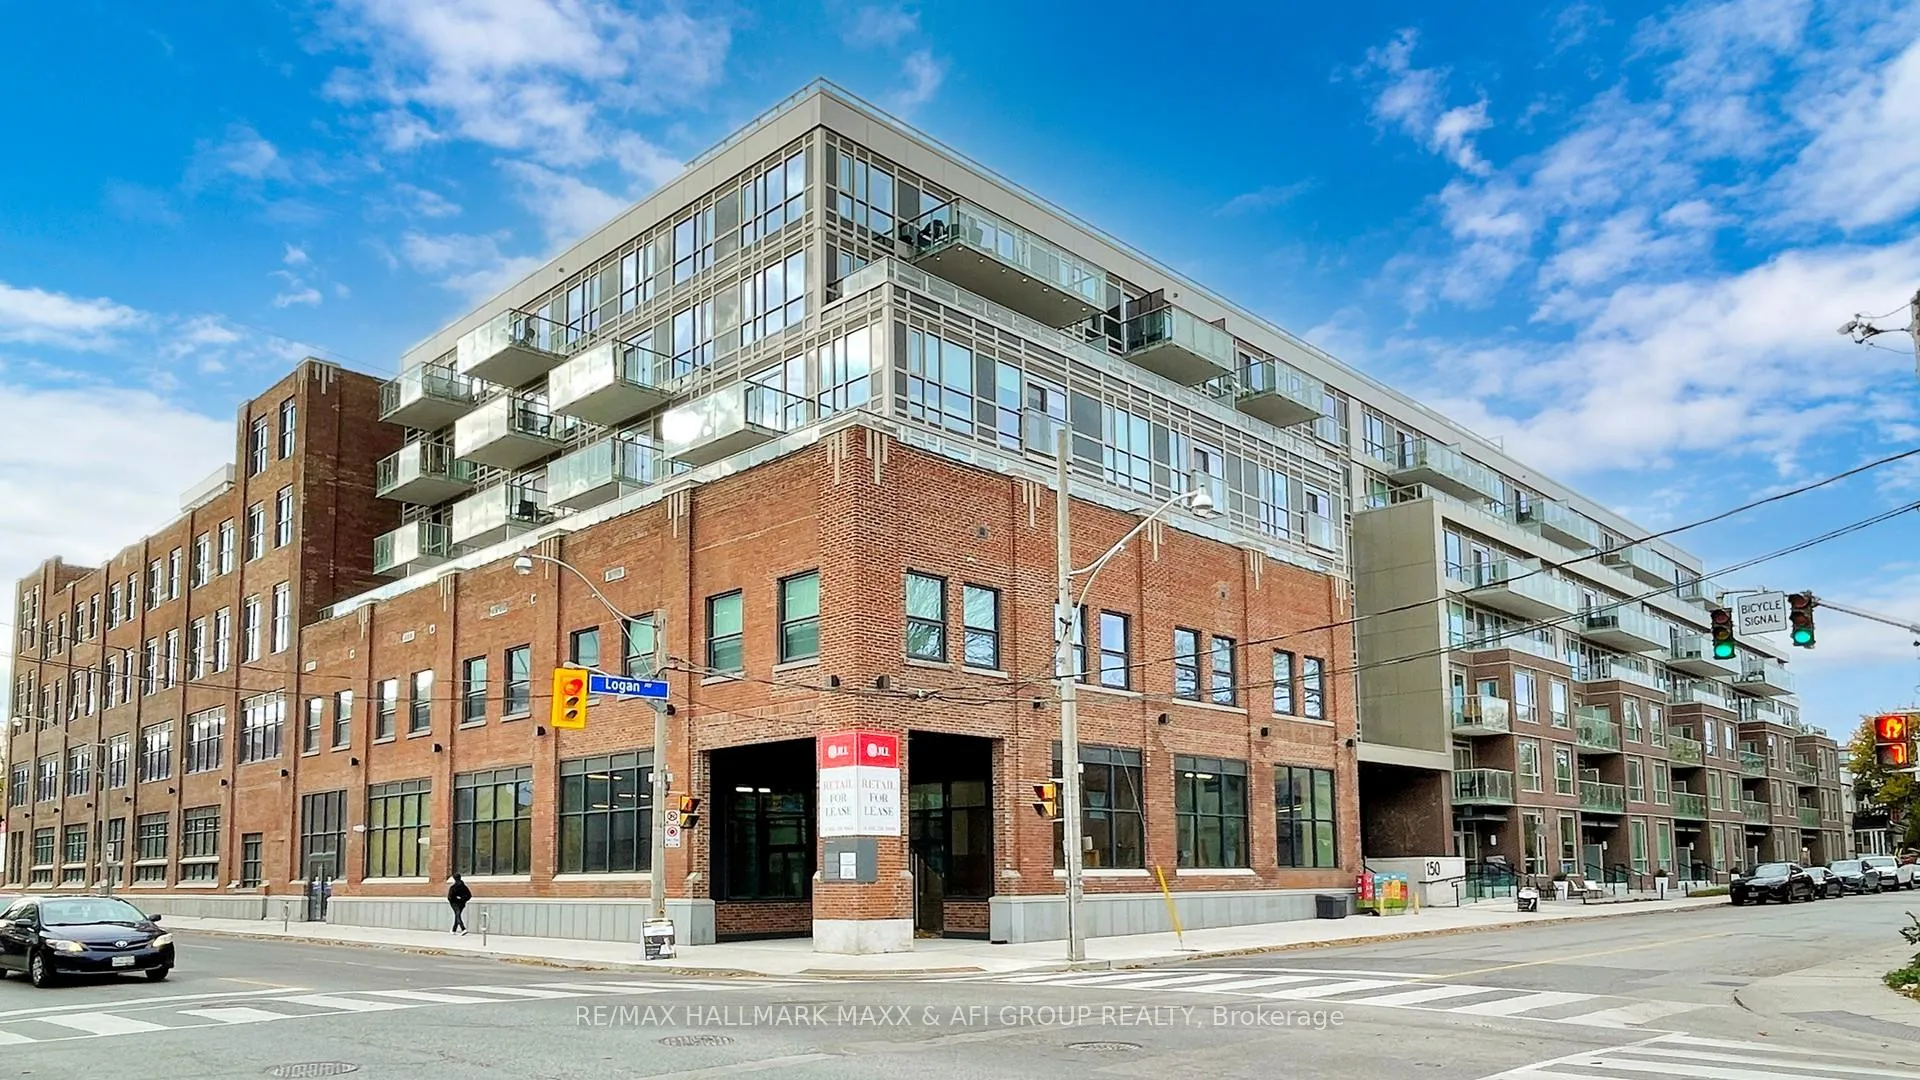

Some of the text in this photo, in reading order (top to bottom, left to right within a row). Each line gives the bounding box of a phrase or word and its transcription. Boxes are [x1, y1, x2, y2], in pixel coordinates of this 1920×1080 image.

[1741, 600, 1782, 614] BICYCLE
[1744, 614, 1780, 627] SIGNAL
[605, 678, 640, 694] Logan
[824, 779, 853, 790] RETAIL
[862, 779, 895, 790] RETAIL
[829, 793, 847, 803] FOR
[869, 792, 889, 803] FOR
[825, 805, 852, 817] LEASE
[864, 805, 894, 817] LEASE
[1426, 861, 1440, 876] 150
